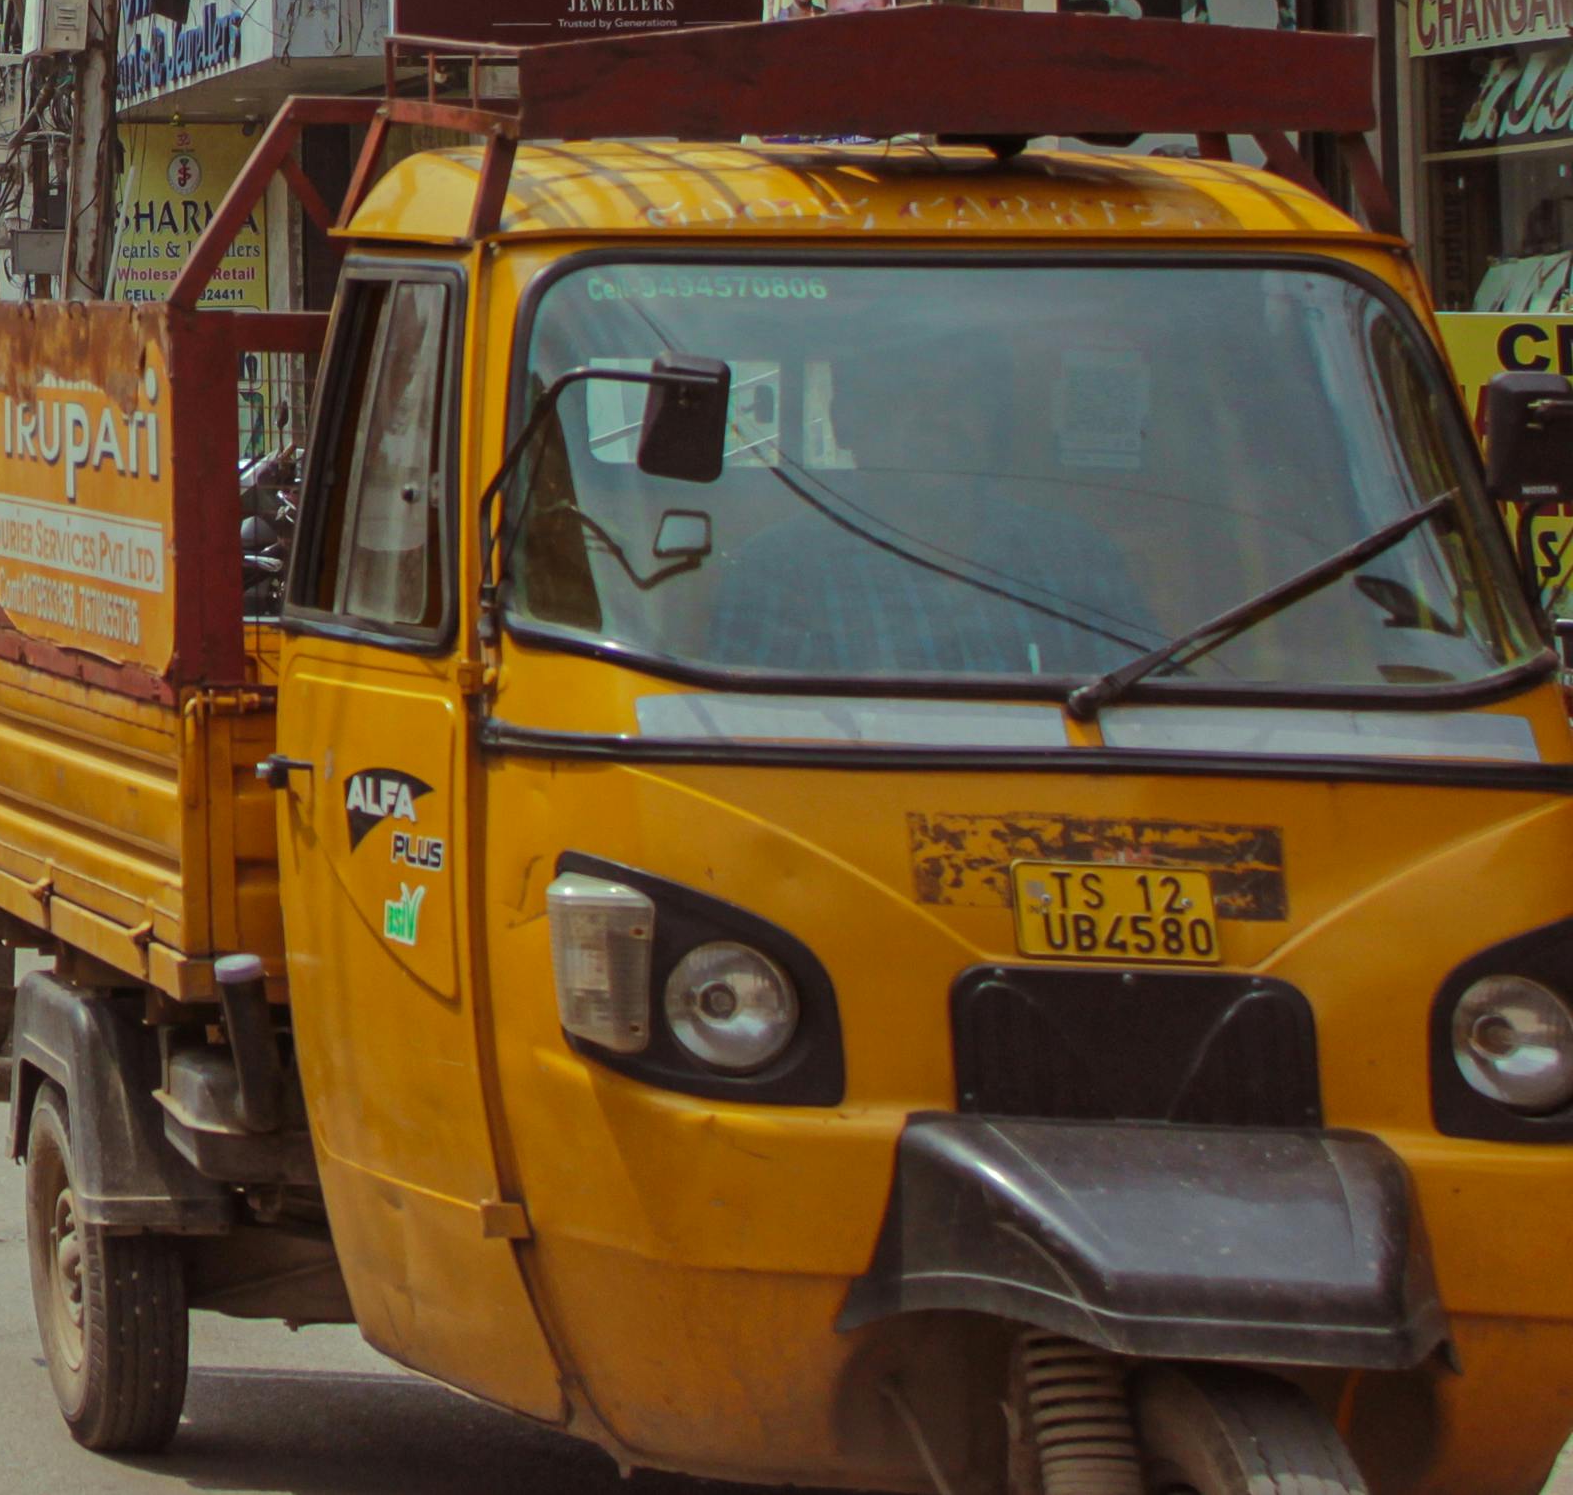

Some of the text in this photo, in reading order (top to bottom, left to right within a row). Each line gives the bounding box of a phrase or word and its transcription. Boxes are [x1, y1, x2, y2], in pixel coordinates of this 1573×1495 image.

[557, 17, 678, 30] Trusted by Generations
[115, 200, 260, 234] SHARA
[165, 241, 180, 258] &
[117, 267, 255, 282] Wholesa Retail
[125, 289, 156, 301] CELL
[346, 774, 417, 823] ALFA
[391, 833, 445, 870] PLUS
[1050, 871, 1186, 915] TS 12
[1041, 912, 1214, 957] UB4580
